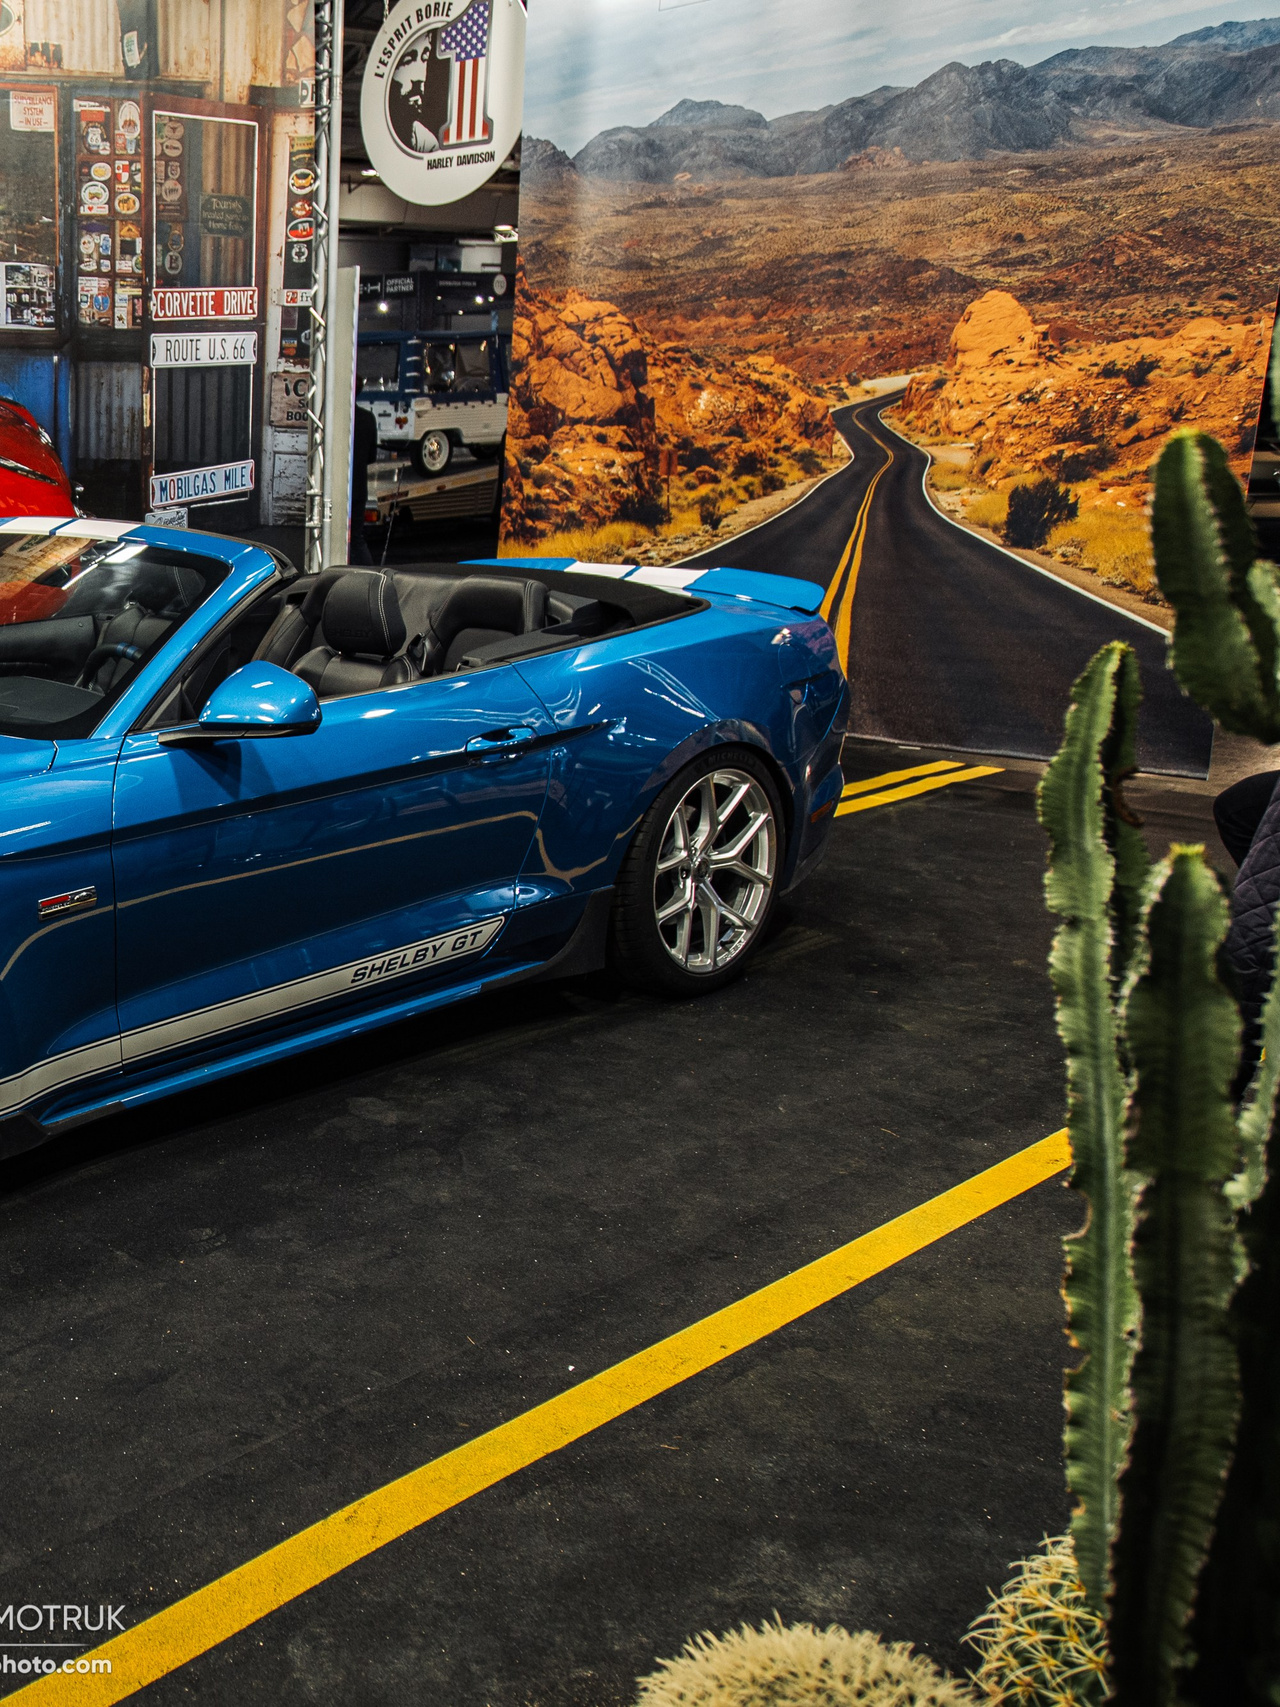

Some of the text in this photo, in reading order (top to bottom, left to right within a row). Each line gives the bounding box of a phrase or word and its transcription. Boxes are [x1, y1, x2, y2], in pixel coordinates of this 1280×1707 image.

[374, 2, 453, 79] L'ESPRIT BORIE
[23, 106, 45, 116] SYSTEM
[426, 151, 496, 171] HARLEY DAVIDSON
[386, 277, 415, 286] OFFICIAL
[386, 284, 414, 293] PARTNER
[157, 290, 254, 317] CORVETTE DRIVE
[165, 338, 246, 363] ROUTE U.S. 66
[283, 377, 309, 398] iC
[159, 465, 247, 503] MOBILGAS MILE
[350, 929, 484, 984] SHELBY GT
